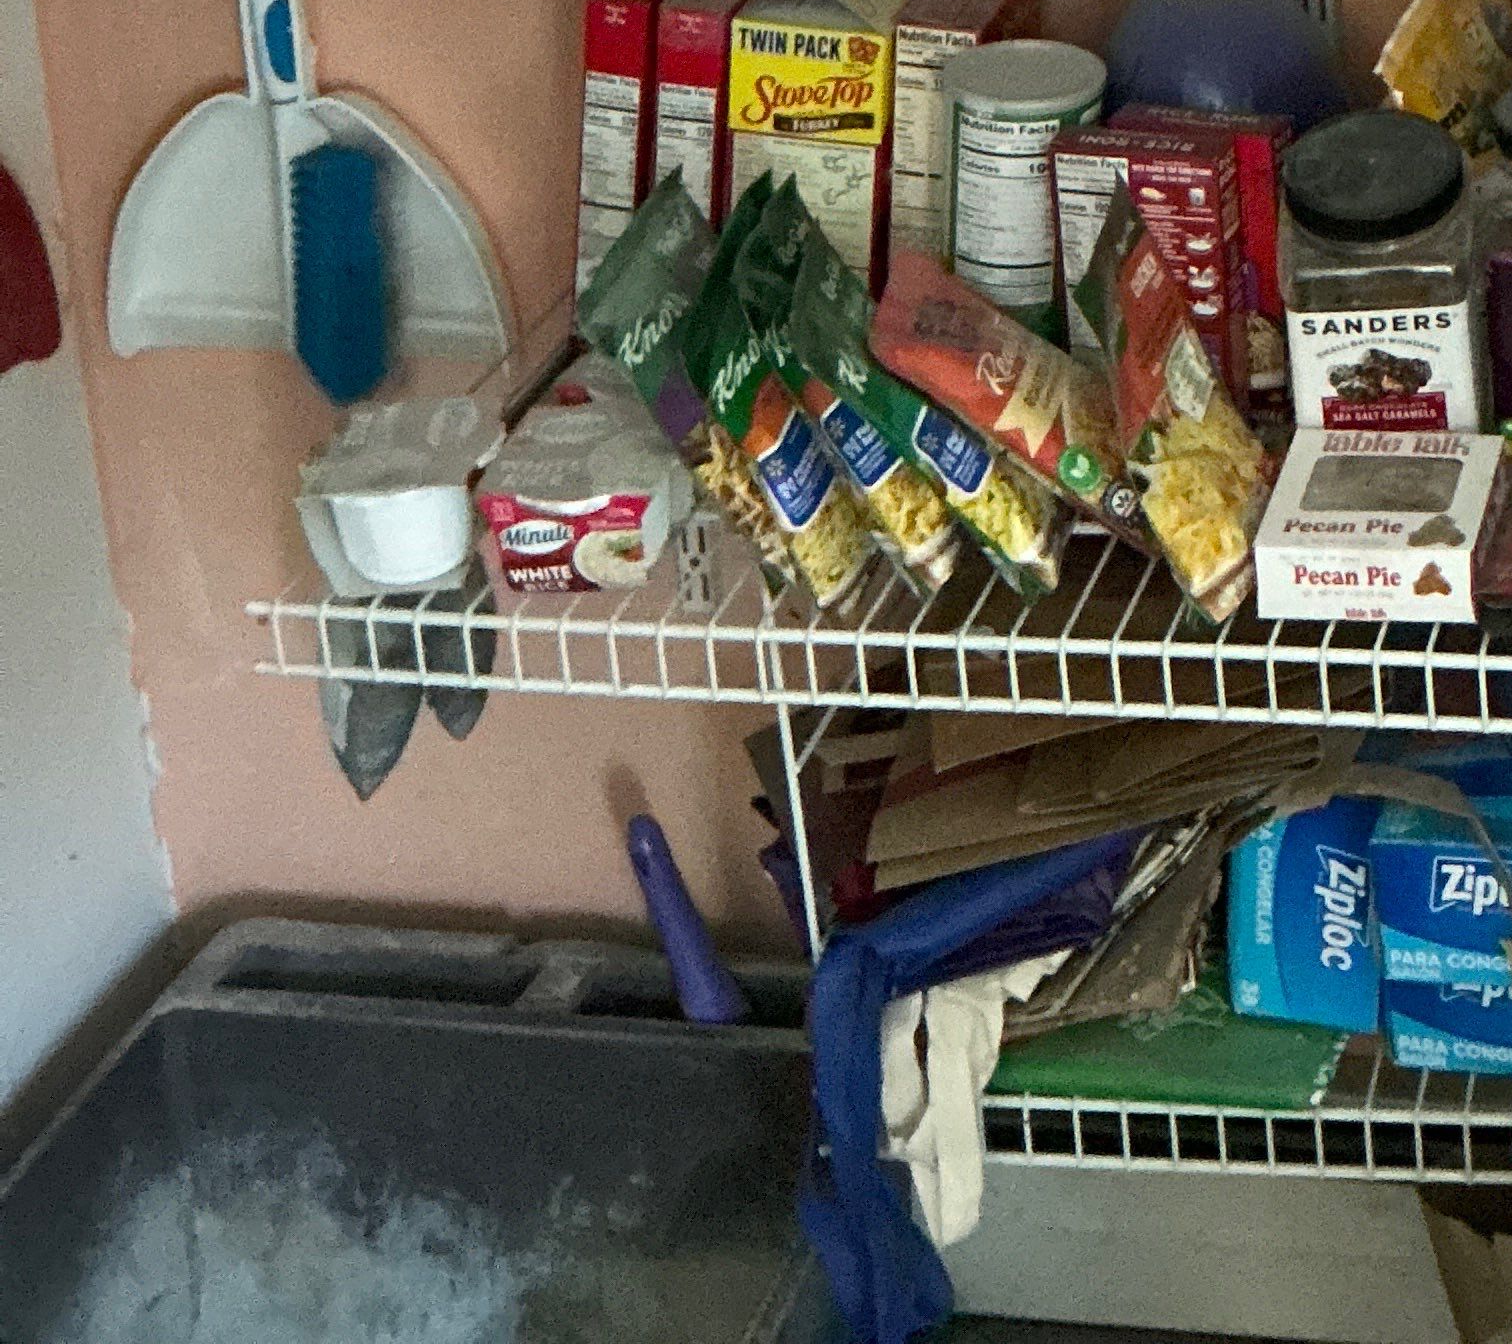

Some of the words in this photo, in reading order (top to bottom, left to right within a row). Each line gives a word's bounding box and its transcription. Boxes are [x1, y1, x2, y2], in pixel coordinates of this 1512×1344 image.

[739, 27, 787, 56] TWIN
[793, 33, 841, 62] PACK
[961, 117, 1014, 134] Nutrition
[1301, 312, 1453, 336] SANDERS
[1333, 412, 1356, 423] SEA
[1357, 411, 1380, 422] SALT
[1382, 408, 1438, 420] CARAMELS
[1283, 518, 1356, 534] Pecan
[1365, 518, 1404, 534] Pie
[508, 563, 573, 584] WHITE
[1294, 564, 1360, 587] Pecan
[1366, 566, 1403, 588] Pie
[1256, 845, 1273, 945] CONGELAR
[1313, 858, 1367, 973] Ziploc
[1391, 950, 1440, 967] PARA
[1400, 1034, 1448, 1057] PARA
